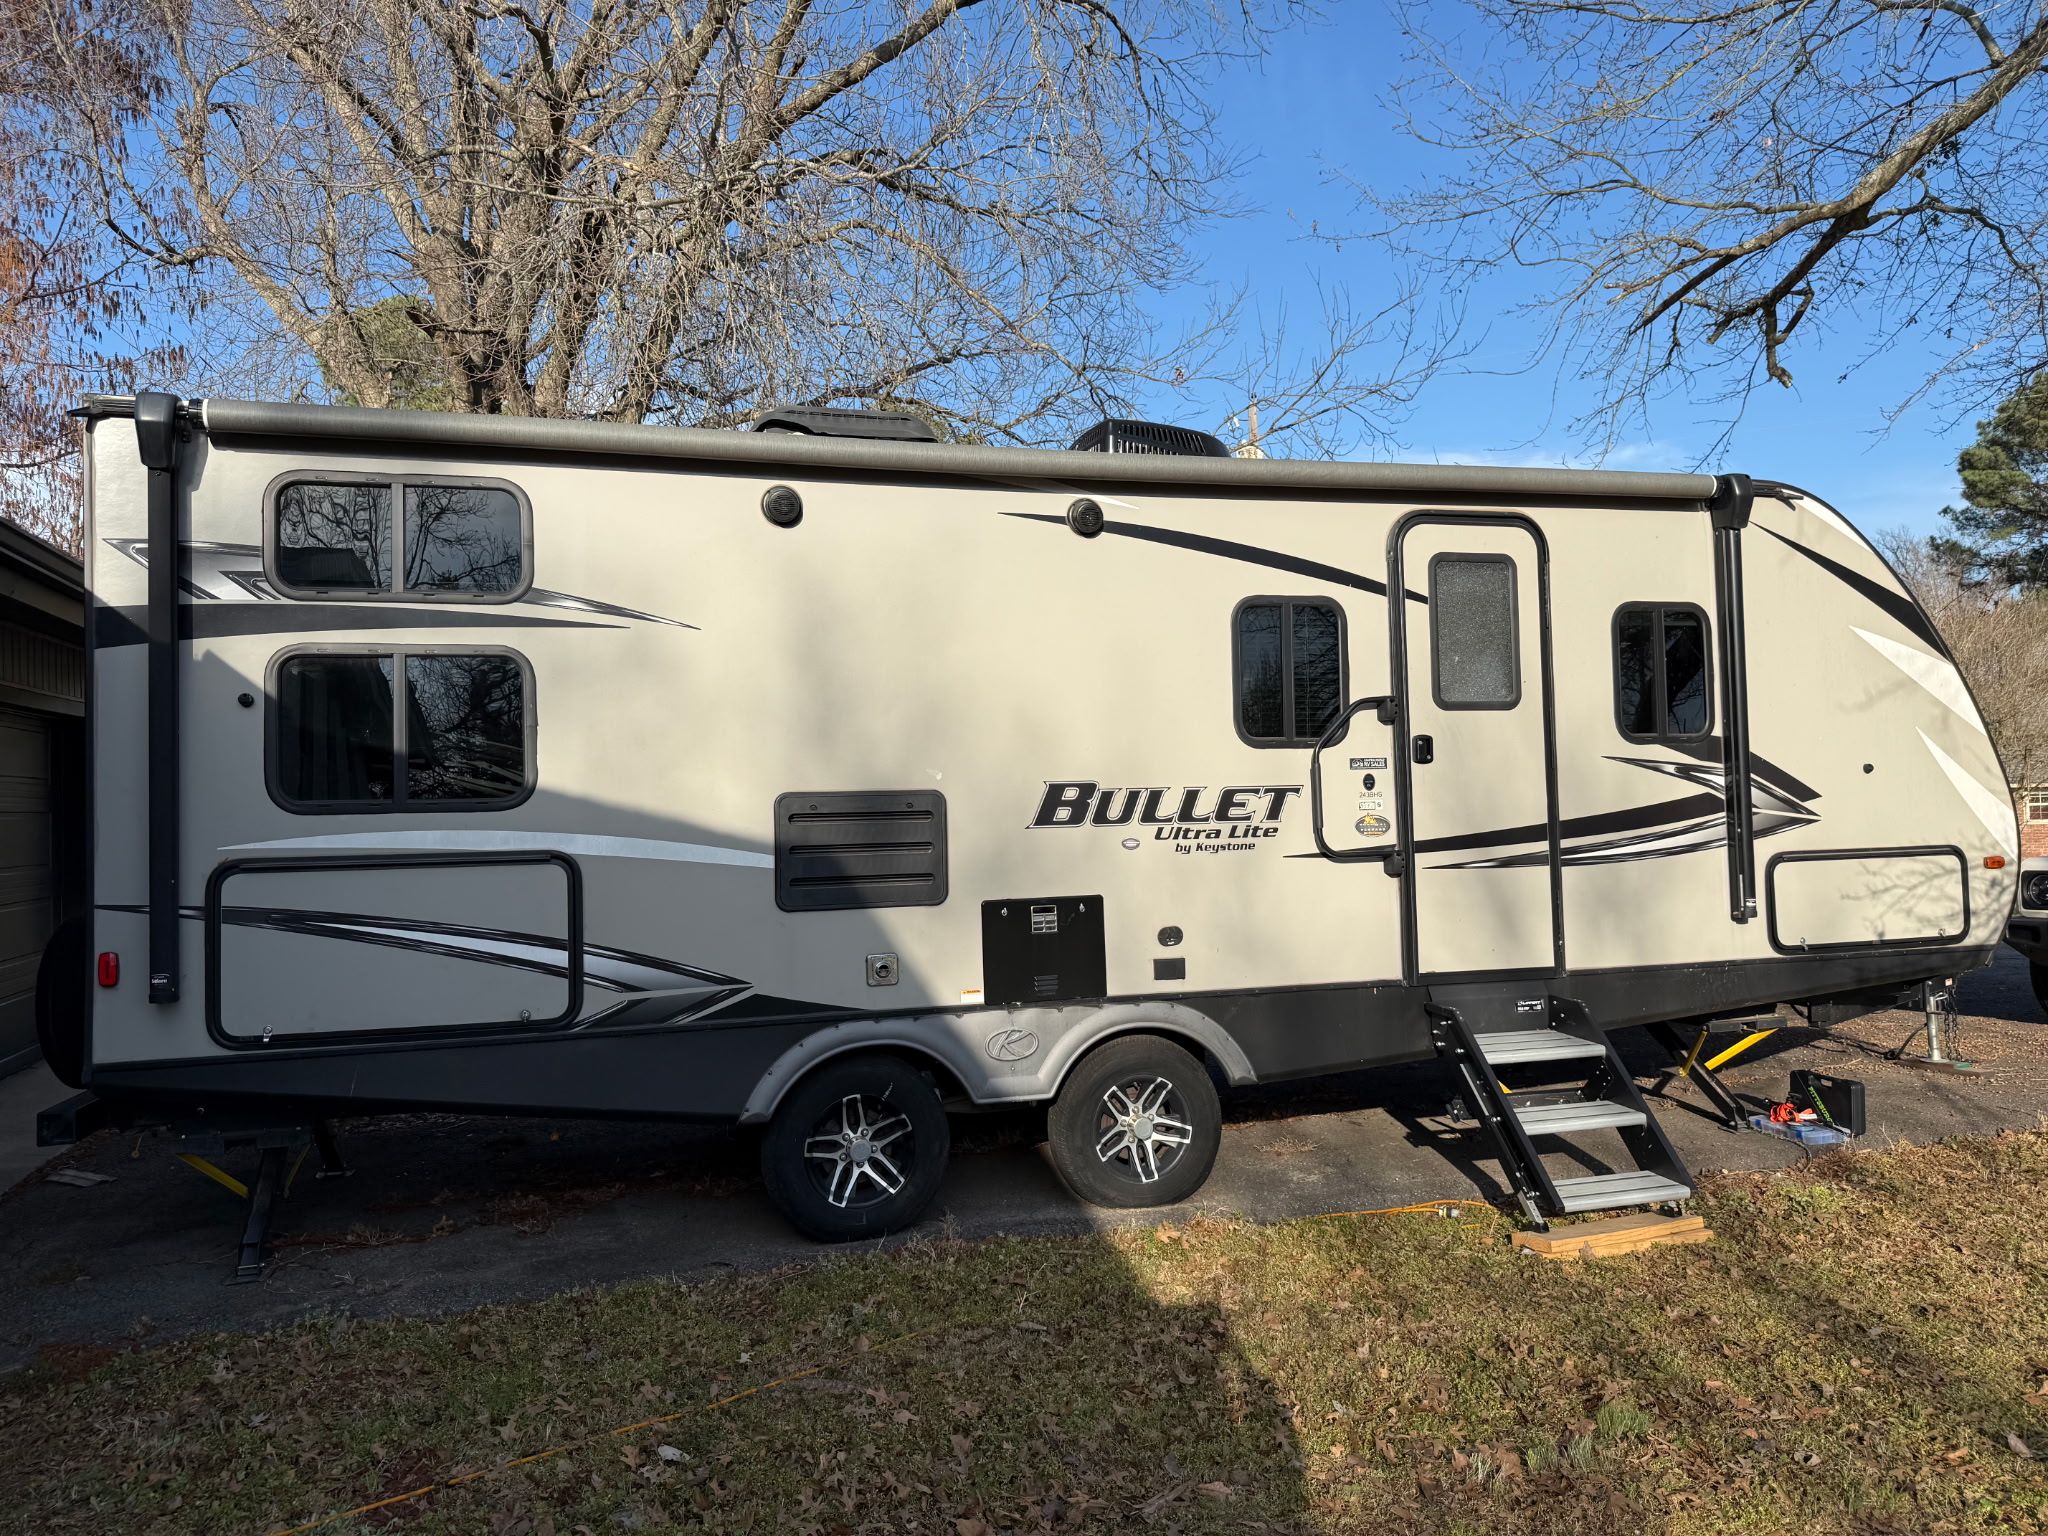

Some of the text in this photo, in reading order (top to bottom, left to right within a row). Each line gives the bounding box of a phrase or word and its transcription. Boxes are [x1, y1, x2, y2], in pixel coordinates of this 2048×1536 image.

[1025, 780, 1304, 829] BULLET
[1154, 825, 1279, 840] Ultra Lite
[1175, 842, 1256, 854] by Keystone
[1807, 1086, 1834, 1123] PITTSBURG
